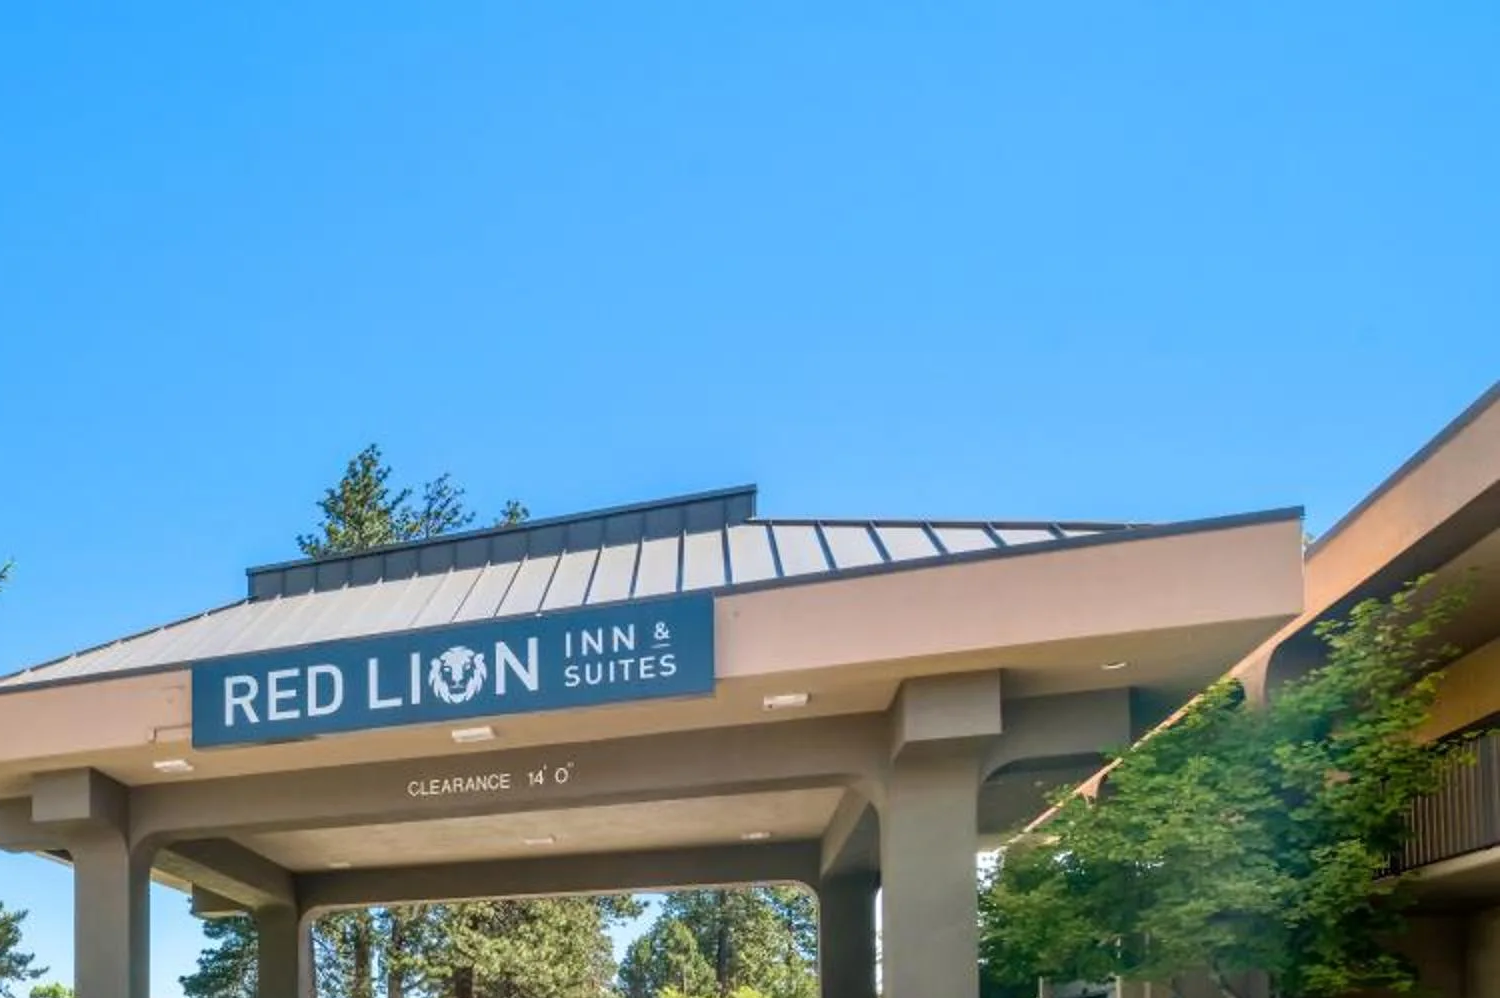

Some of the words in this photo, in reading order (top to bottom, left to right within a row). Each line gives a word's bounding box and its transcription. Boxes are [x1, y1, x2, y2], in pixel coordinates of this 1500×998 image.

[565, 623, 635, 659] INN
[653, 621, 671, 641] &
[564, 653, 677, 688] SUITES
[223, 663, 344, 727] RED
[407, 773, 512, 797] CLEARANCE
